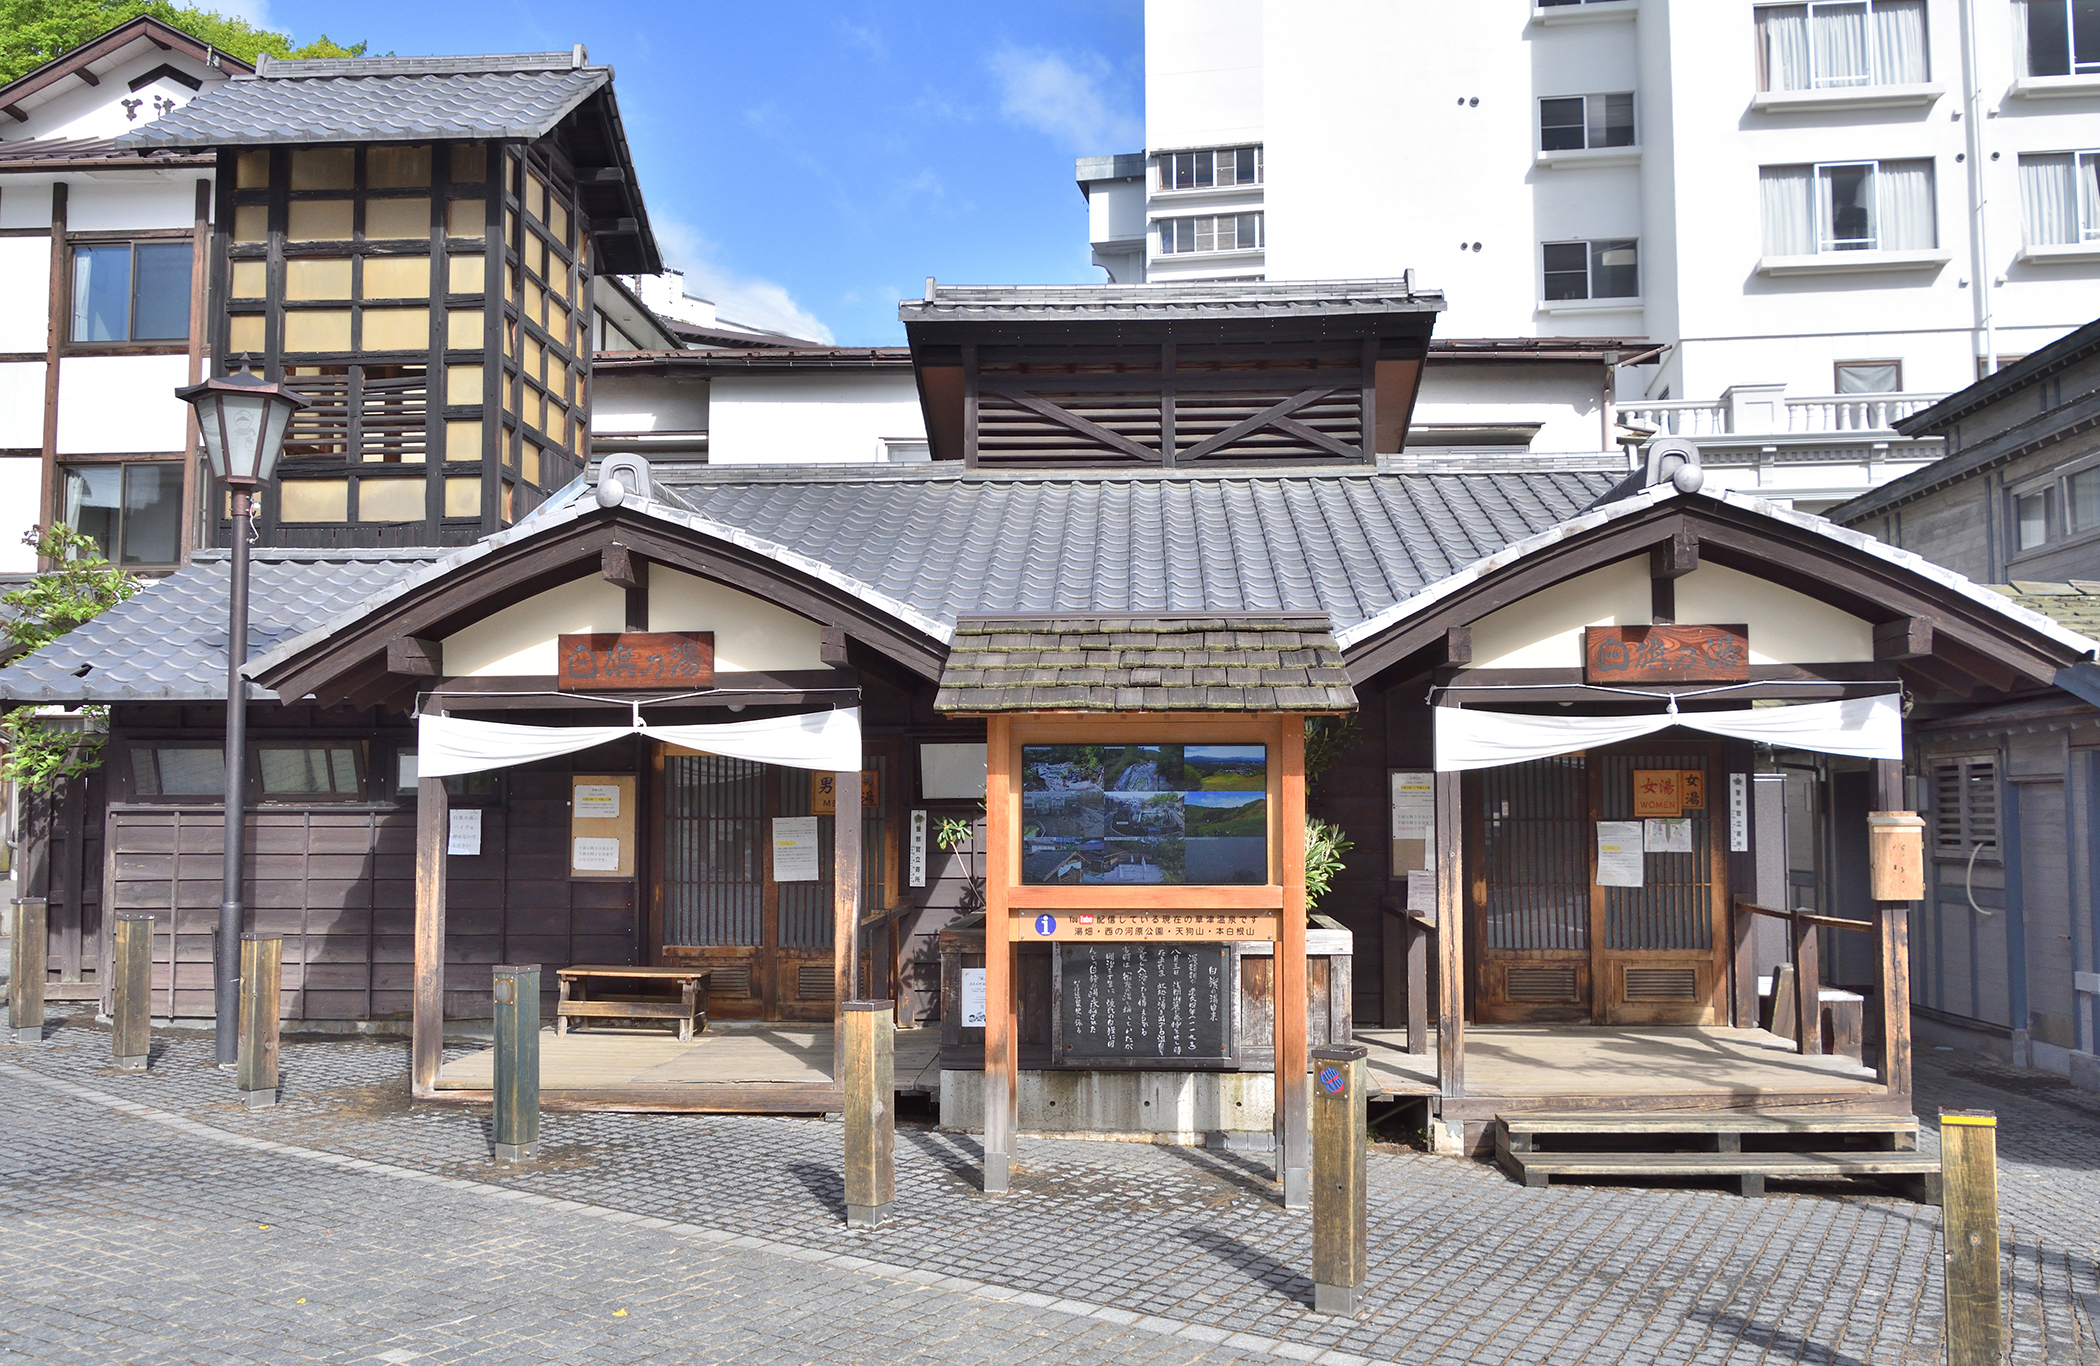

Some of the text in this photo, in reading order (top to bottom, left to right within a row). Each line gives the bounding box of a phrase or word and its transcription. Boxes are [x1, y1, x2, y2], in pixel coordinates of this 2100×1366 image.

[568, 643, 705, 679] 白旗乃湯
[818, 777, 834, 794] 男
[1641, 778, 1675, 795] 女湯
[1685, 774, 1700, 806] 女湯
